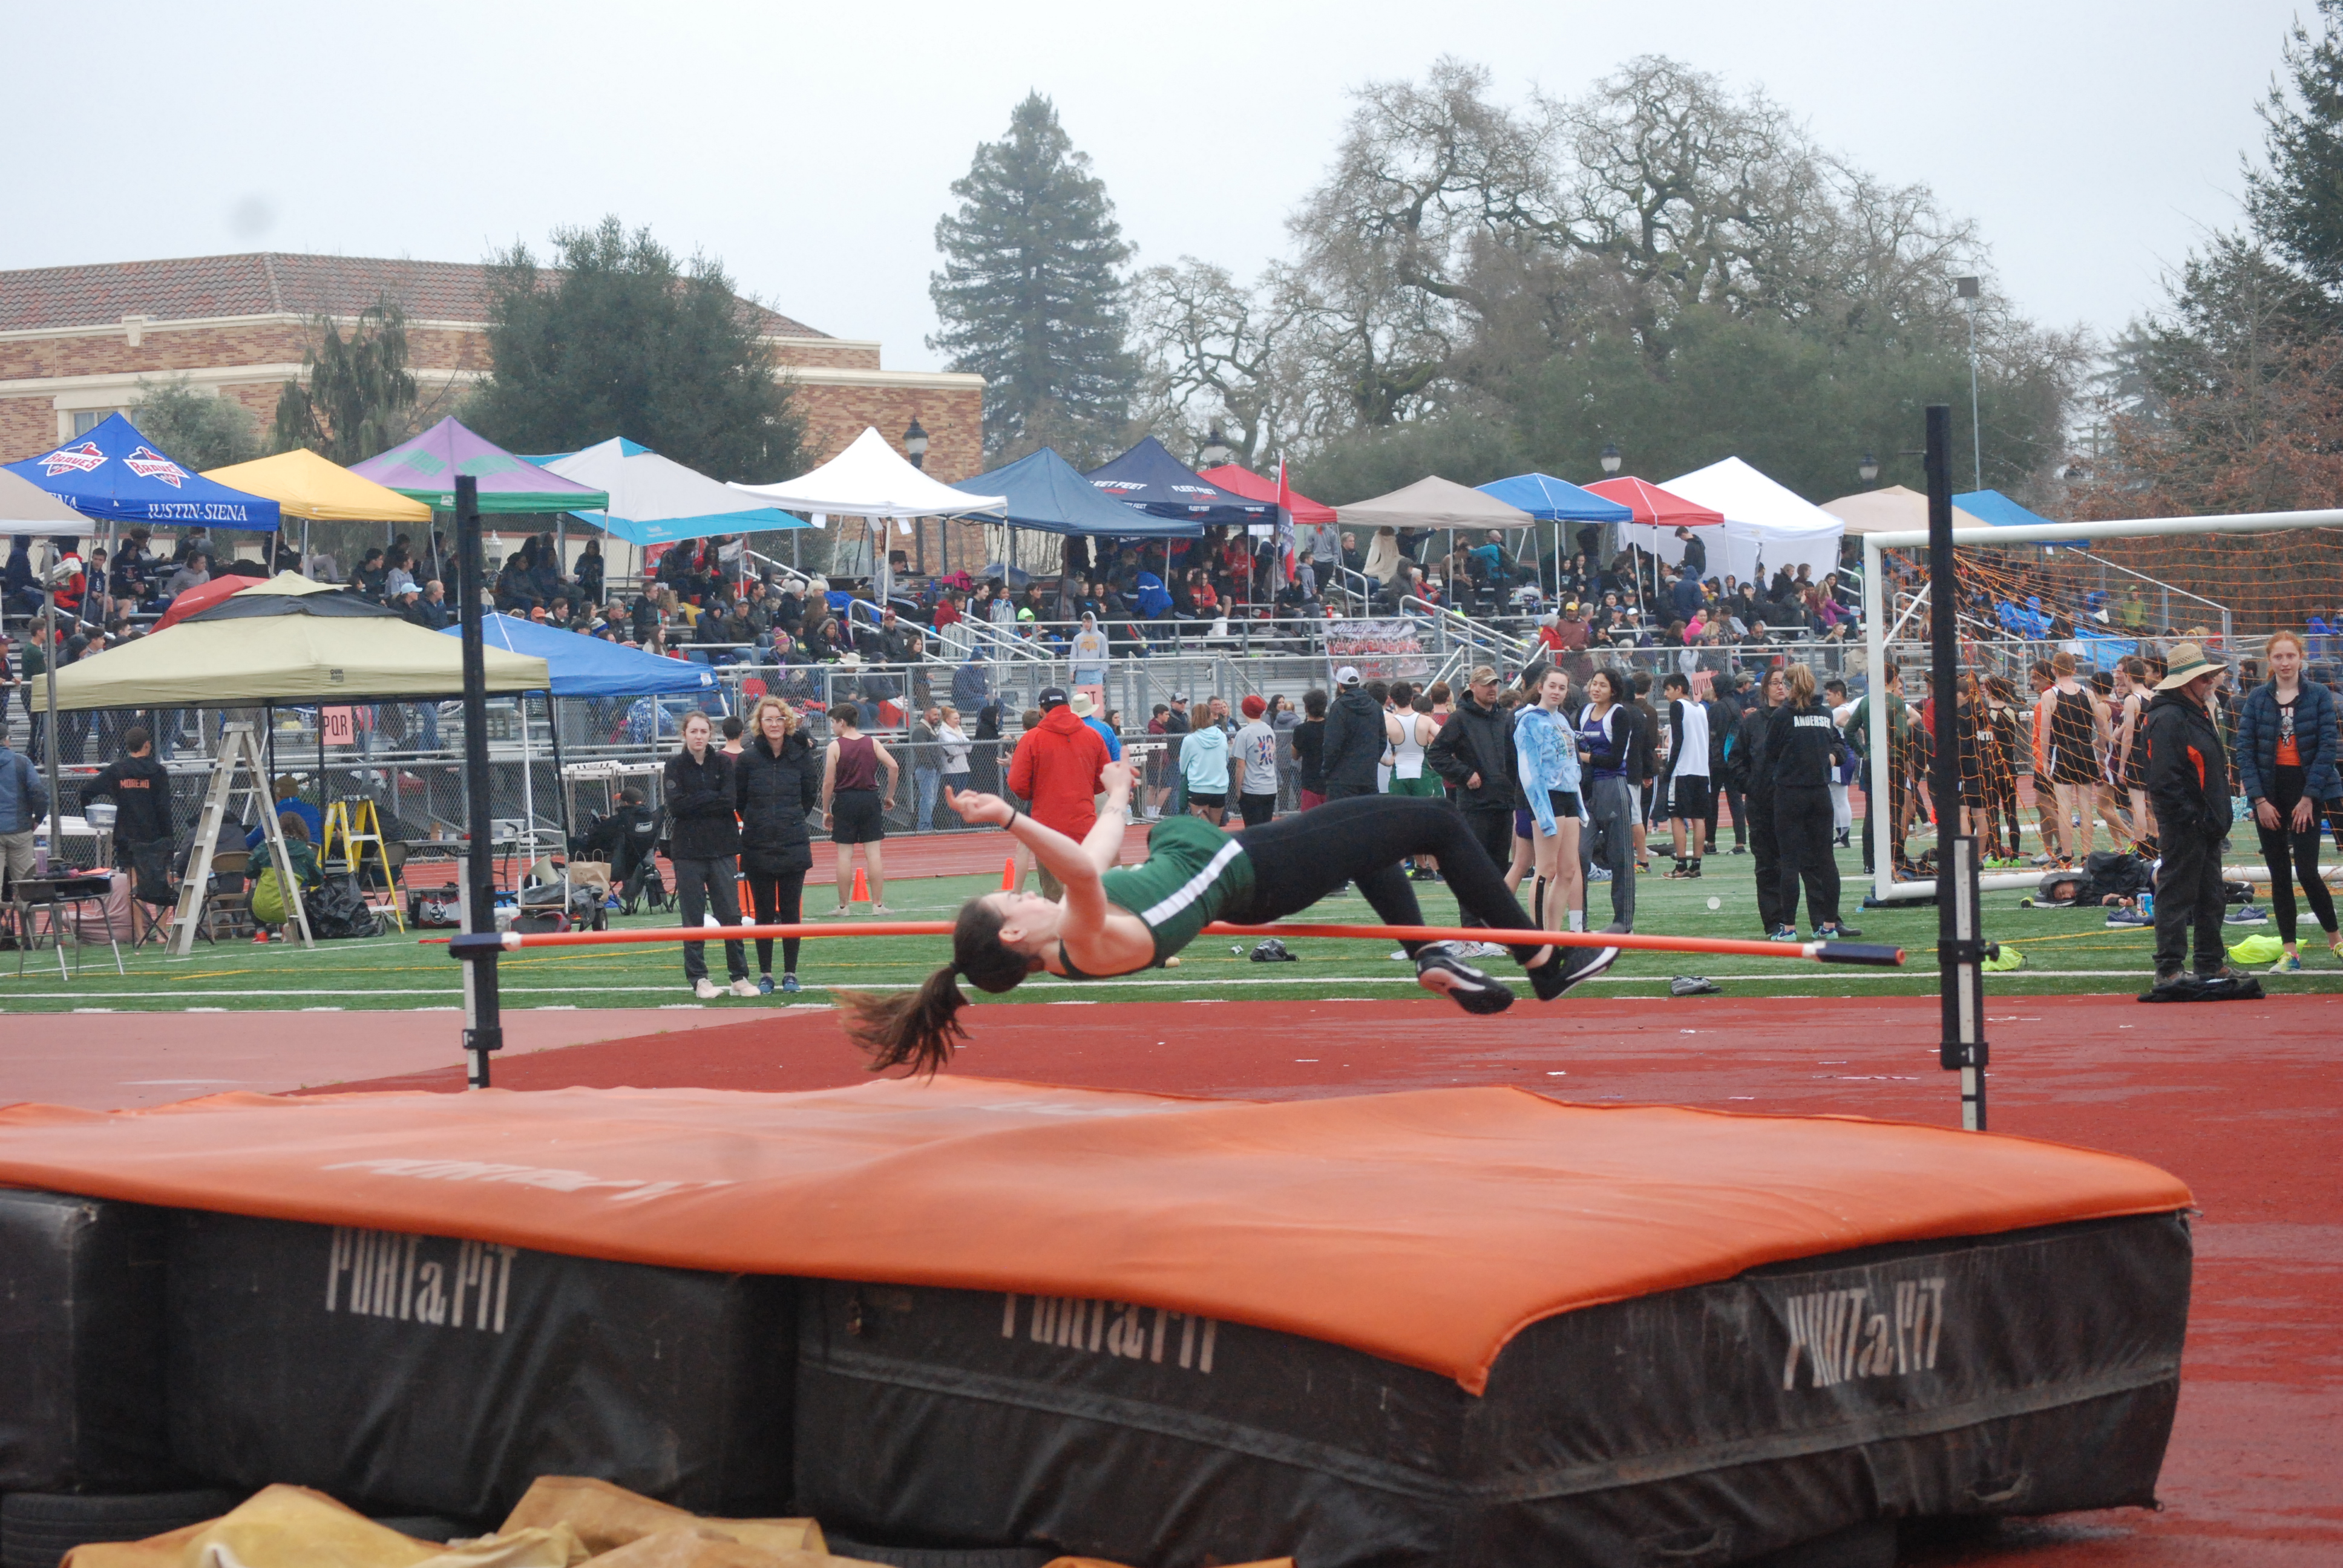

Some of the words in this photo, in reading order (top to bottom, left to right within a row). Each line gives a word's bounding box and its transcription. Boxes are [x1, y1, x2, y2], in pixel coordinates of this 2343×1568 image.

[44, 453, 103, 469] BRAVES
[128, 462, 185, 476] BRAVES
[1115, 482, 1148, 490] FEET
[1195, 486, 1216, 495] FEET
[148, 503, 248, 521] JUSTIN-SIENA
[323, 714, 348, 737] PQR
[120, 779, 149, 789] MORENO
